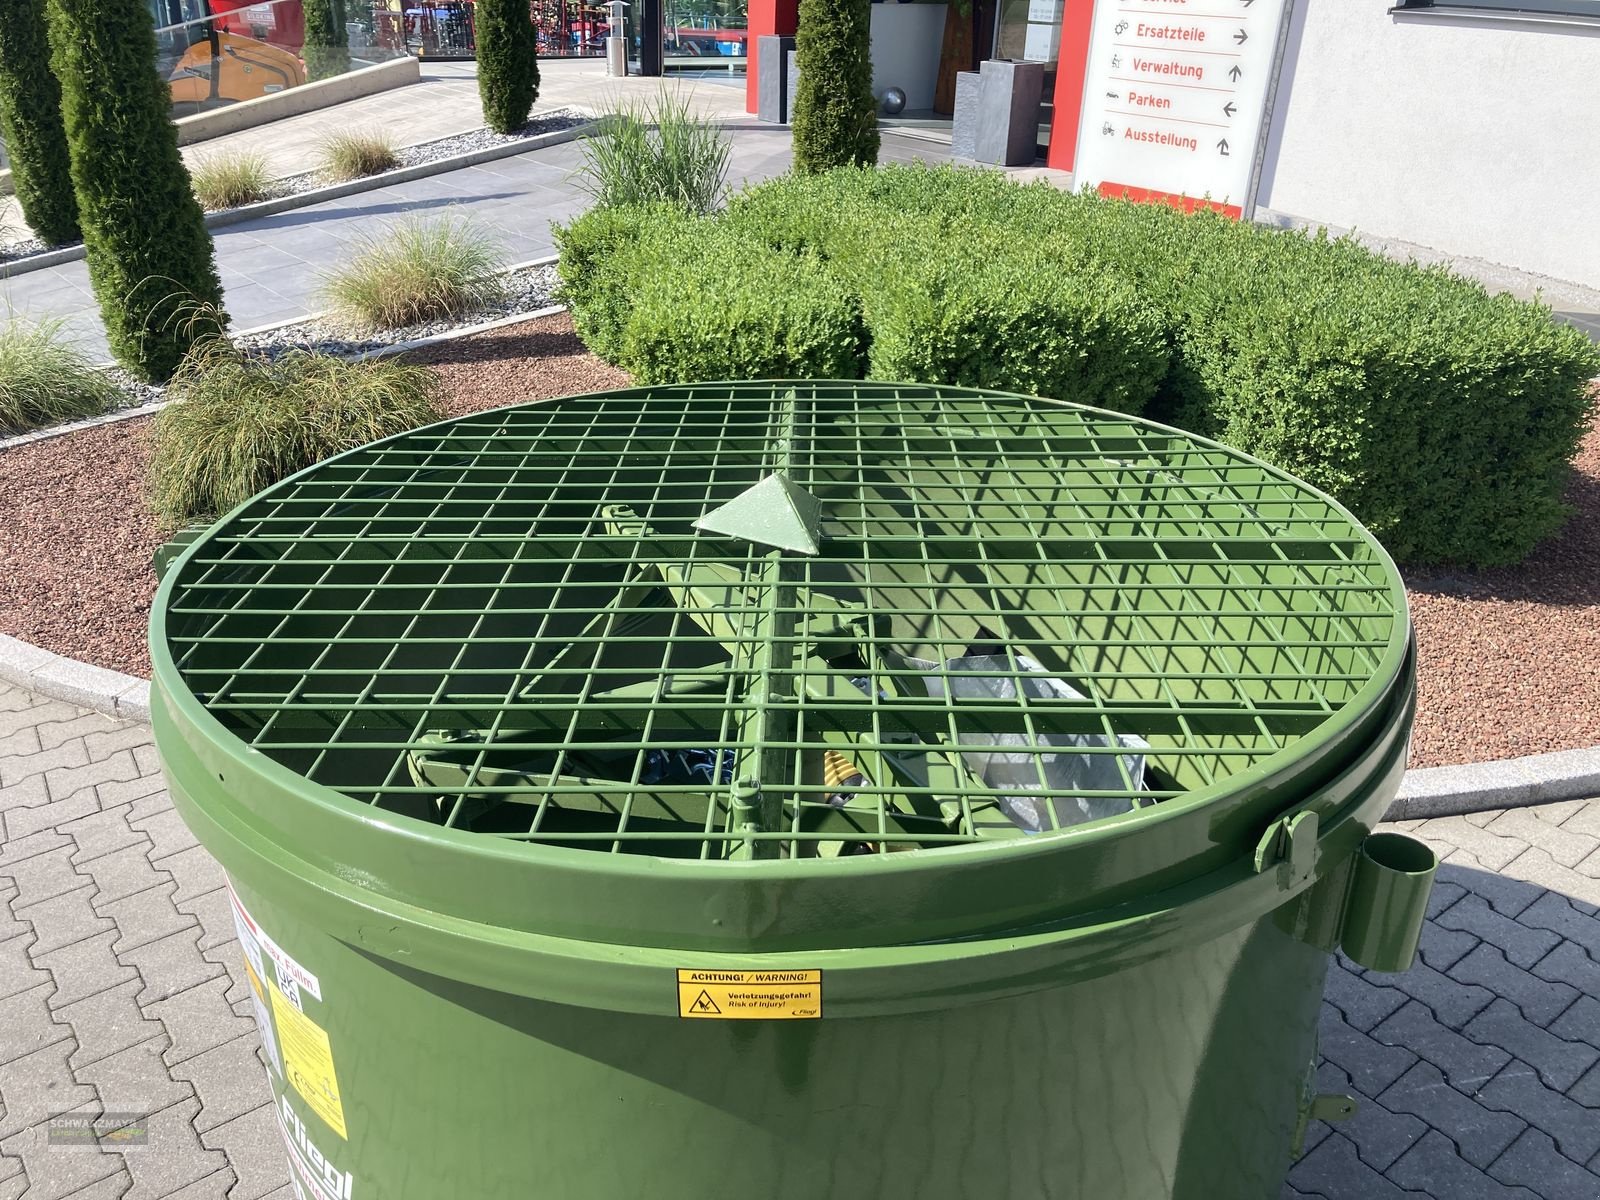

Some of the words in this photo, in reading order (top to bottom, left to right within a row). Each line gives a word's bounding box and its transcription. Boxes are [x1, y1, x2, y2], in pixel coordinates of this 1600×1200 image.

[1136, 23, 1206, 41] Ersatzteile
[1132, 58, 1204, 80] Verwaltung
[1128, 92, 1171, 109] Parken
[1124, 127, 1198, 151] Ausstellung
[284, 959, 317, 994] Füllm.
[691, 973, 744, 981] ACHTUNG!
[728, 992, 812, 1001] Verletzungsgefahr!
[759, 1001, 786, 1009] Injury!
[282, 1094, 353, 1200] Fliegl
